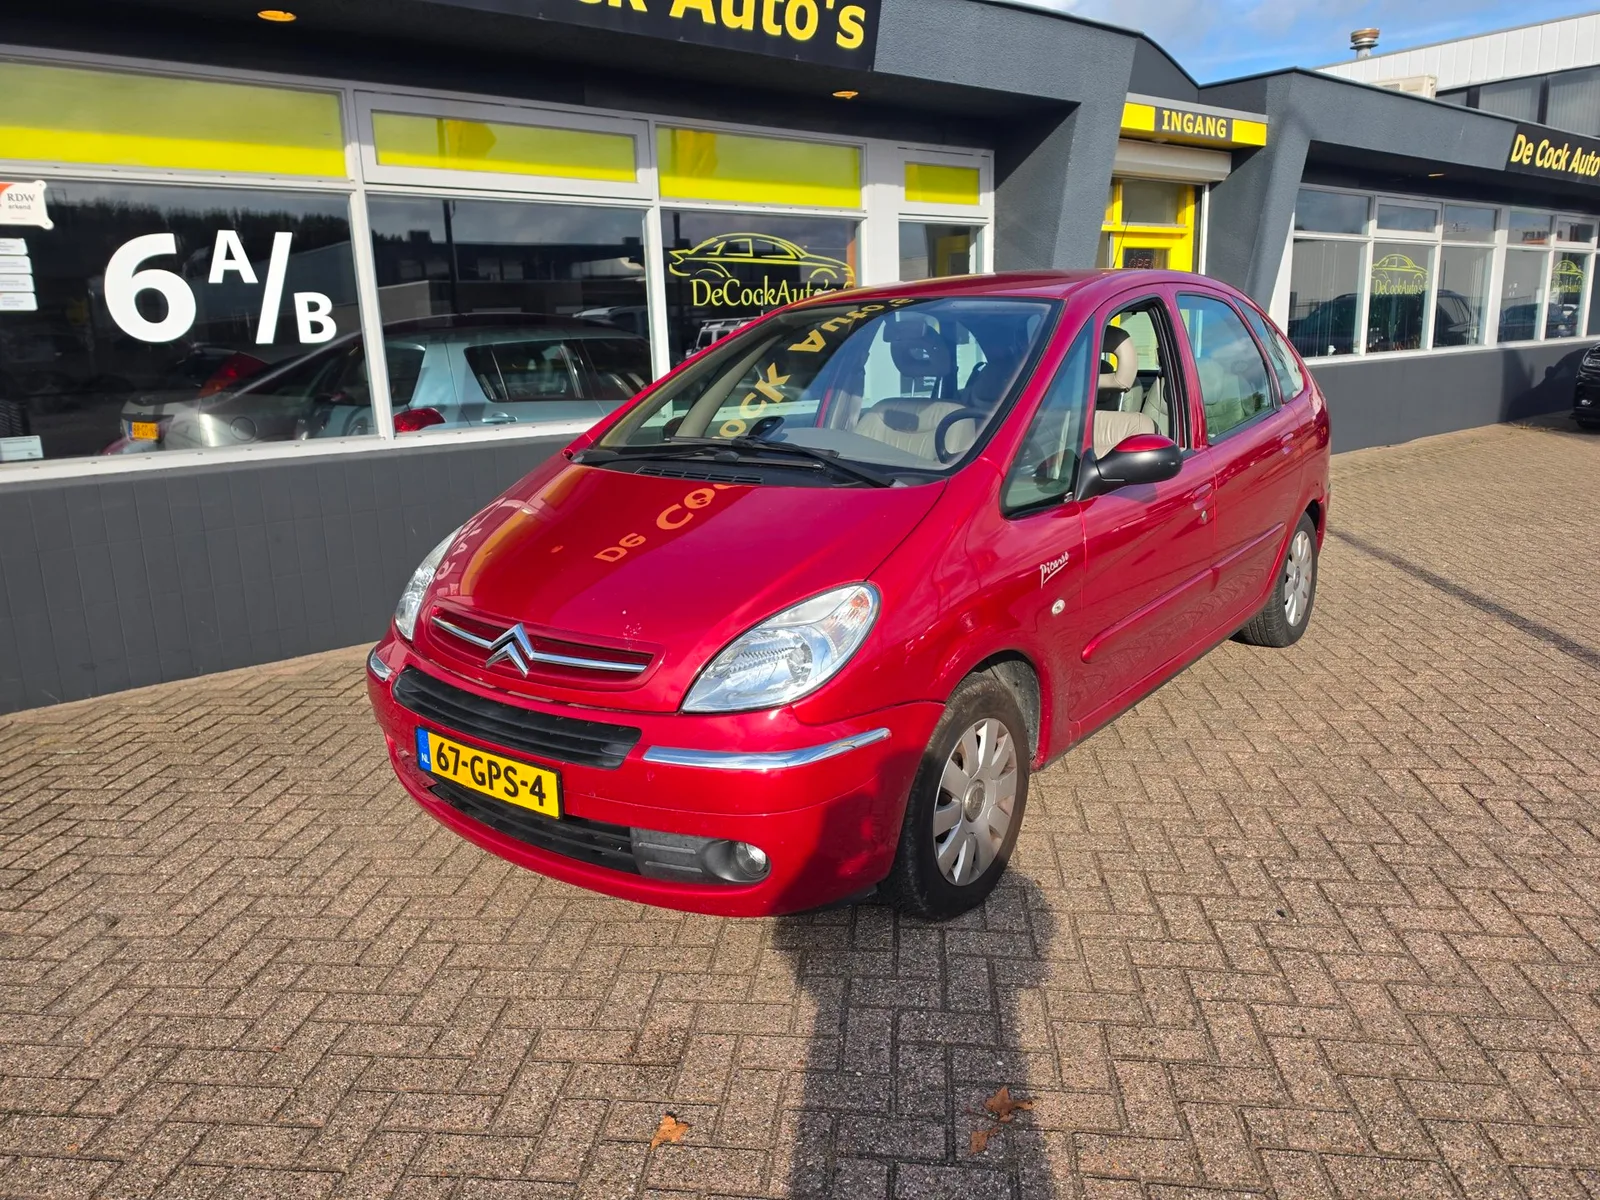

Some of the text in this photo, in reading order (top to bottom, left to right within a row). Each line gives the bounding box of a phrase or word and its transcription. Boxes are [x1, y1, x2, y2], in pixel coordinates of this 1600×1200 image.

[1162, 110, 1227, 138] INGANG
[1510, 134, 1534, 165] De
[1535, 138, 1571, 171] Cock
[7, 193, 35, 202] RDW
[1040, 551, 1069, 588] Picasso
[421, 752, 430, 764] NL
[436, 742, 546, 806] 67-GPS-4
